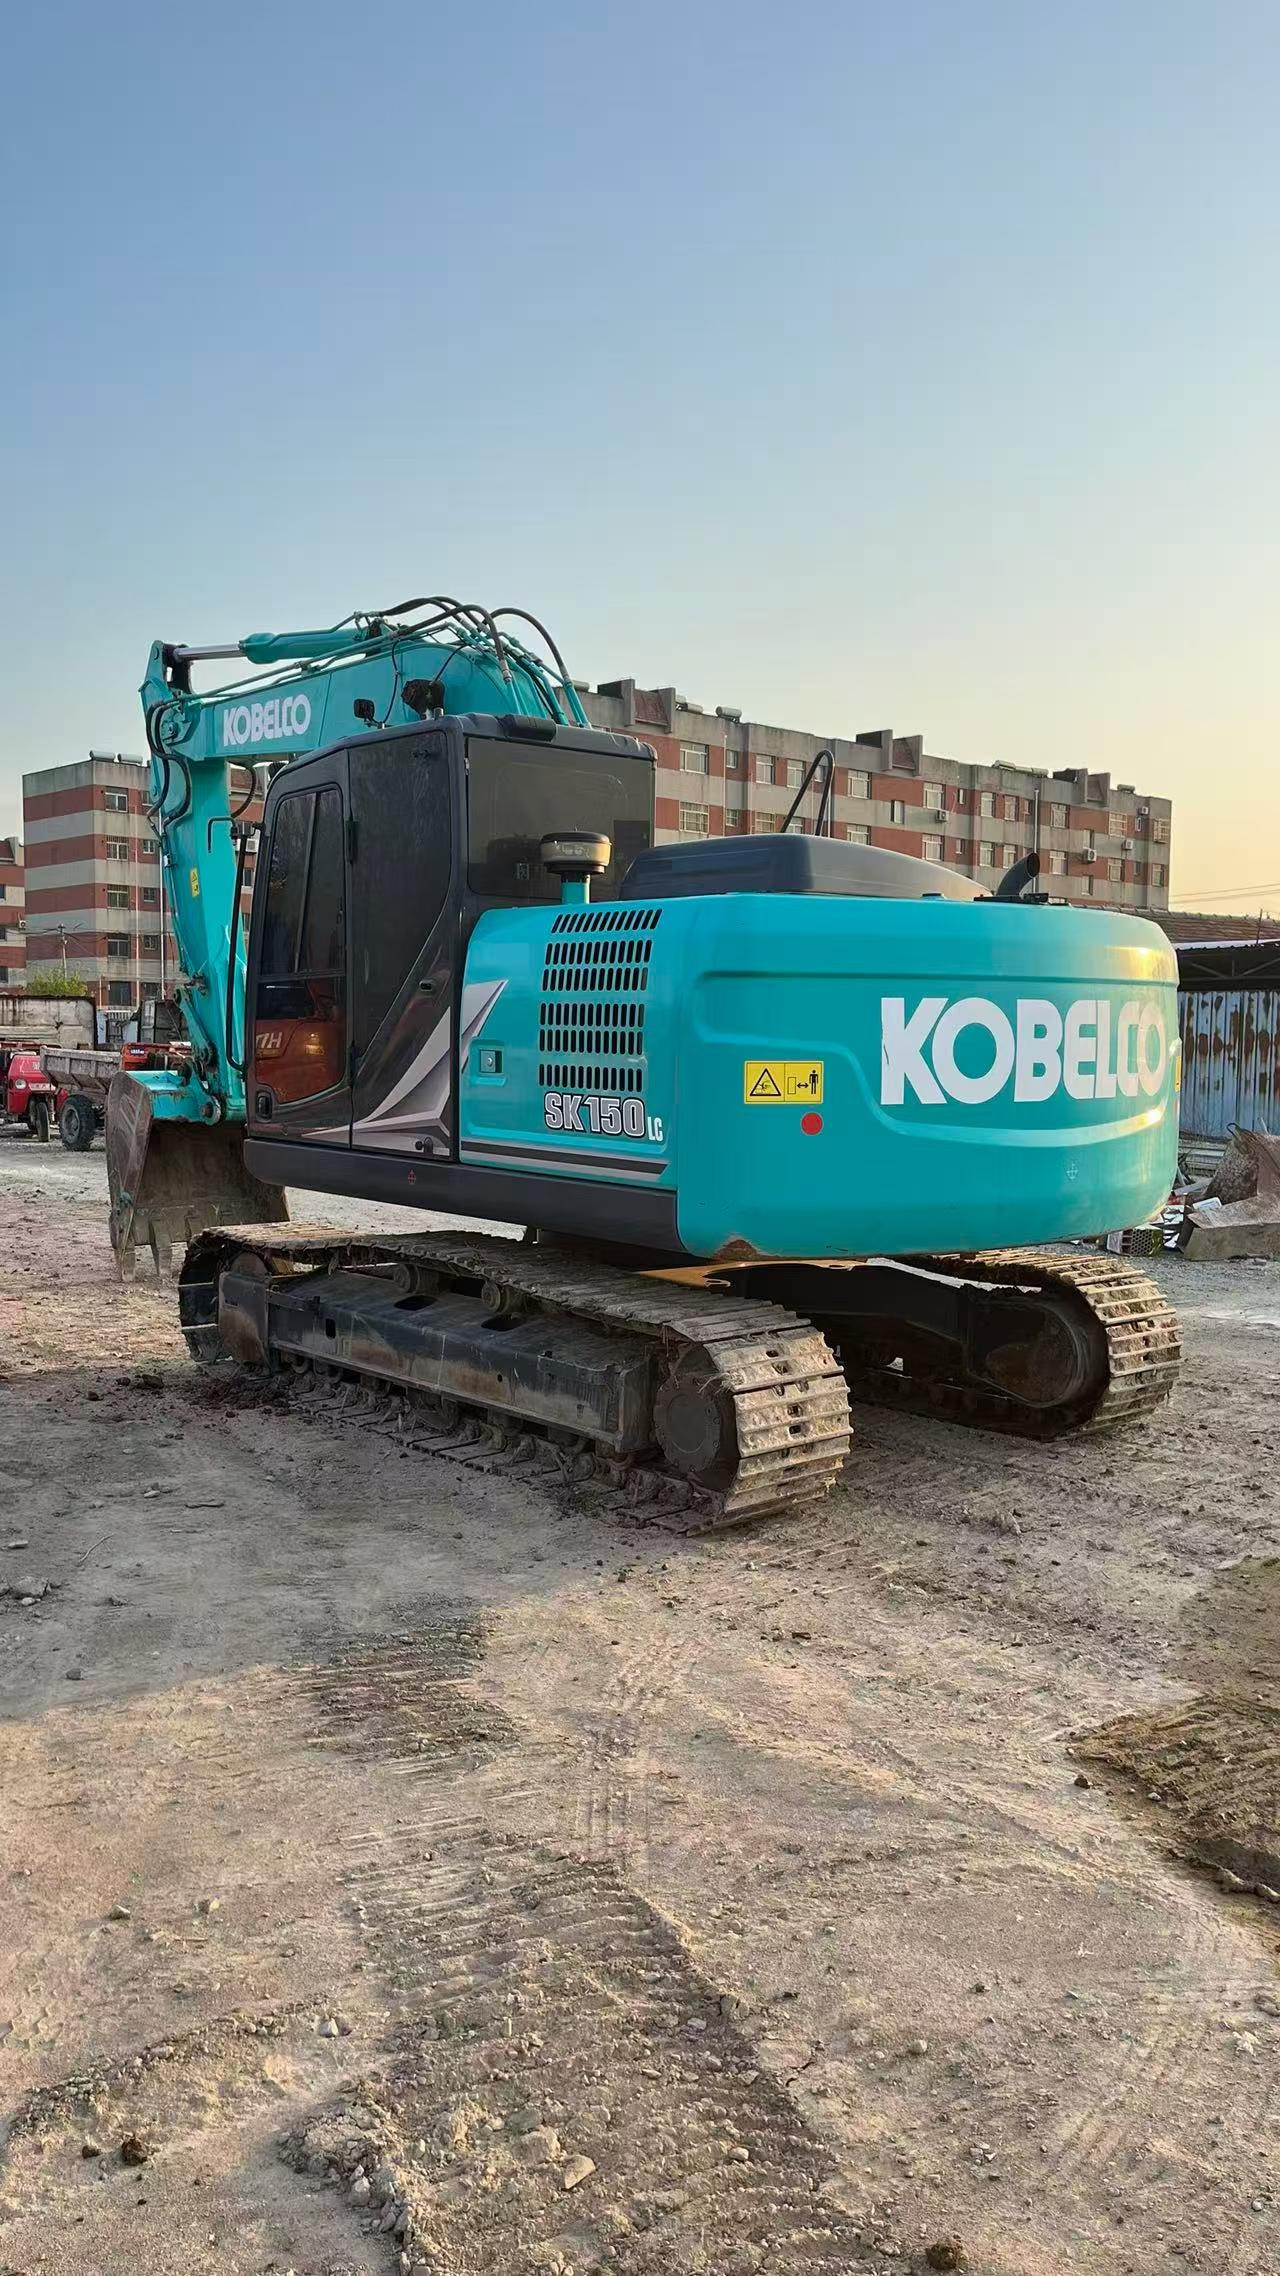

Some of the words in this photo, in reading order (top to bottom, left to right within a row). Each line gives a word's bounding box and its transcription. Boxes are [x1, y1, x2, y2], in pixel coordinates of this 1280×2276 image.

[223, 694, 312, 747] KOBELCO
[880, 997, 1165, 1105] KOBELCO
[544, 1091, 646, 1138] SK150
[647, 1116, 664, 1142] LC
